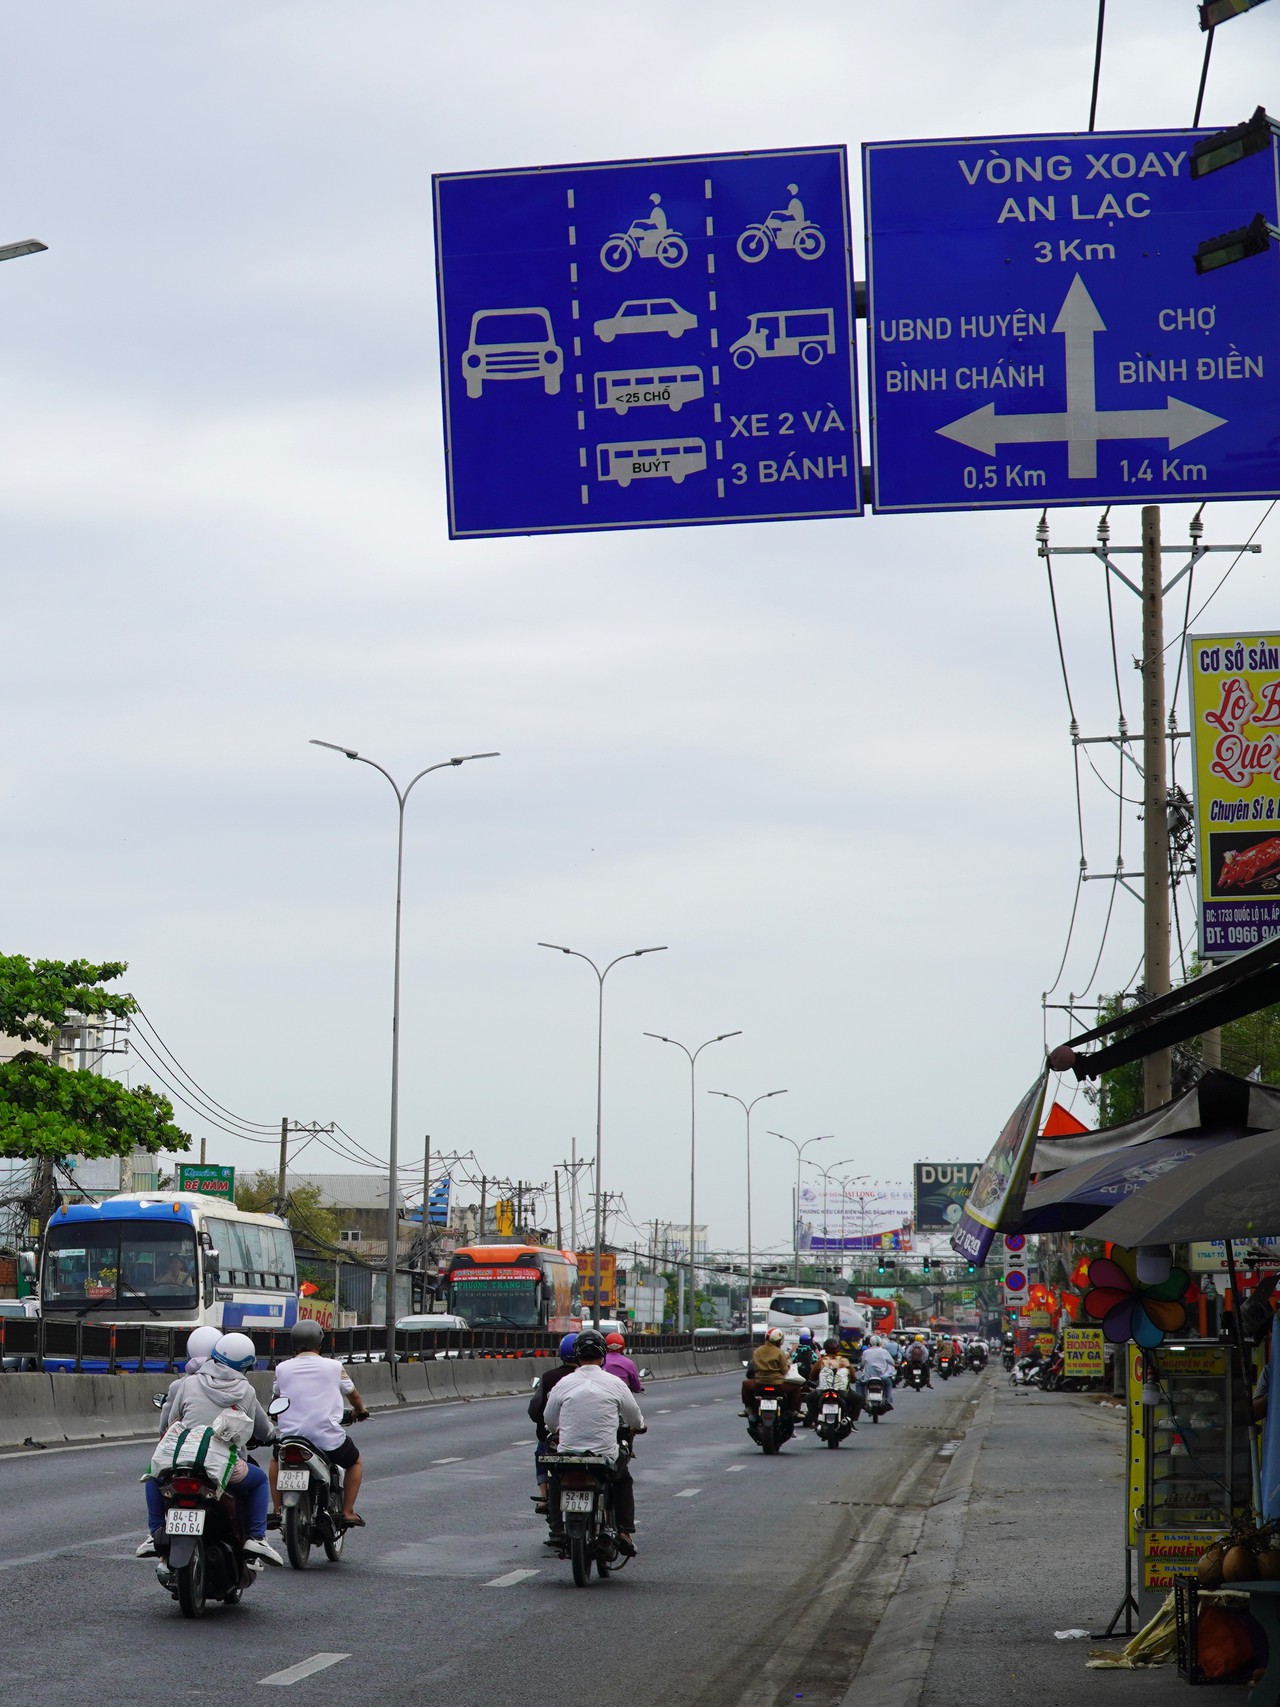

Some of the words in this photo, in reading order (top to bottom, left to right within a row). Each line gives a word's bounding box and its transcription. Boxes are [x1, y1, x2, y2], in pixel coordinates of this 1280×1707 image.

[959, 149, 1073, 185] VÒNG
[1085, 151, 1188, 181] XOAY
[996, 195, 1055, 223] AN
[1072, 192, 1151, 227] LẠC
[880, 317, 952, 342] UBND
[960, 308, 1046, 342] HUYỆN
[1158, 304, 1217, 335] CHỢ
[886, 361, 947, 392] BÌNH
[955, 358, 1045, 390] CHÁNH
[1119, 351, 1188, 384] BÌNH
[1196, 344, 1264, 381] ĐIỀN
[644, 386, 672, 403] CHỖ
[729, 414, 770, 438] XE
[778, 412, 796, 435] 2
[802, 402, 846, 433] VÀ
[631, 455, 671, 474] BUÝT
[731, 462, 749, 485] 3
[758, 451, 848, 484] BÁNH
[963, 465, 998, 490] 0,5
[1006, 464, 1046, 488] Km
[1120, 459, 1154, 484] 1,4
[1162, 458, 1208, 482] Km
[1200, 647, 1221, 672] CƠ
[1224, 641, 1245, 671] SỞ
[1248, 641, 1279, 670] SẢN
[1205, 678, 1250, 732] Lò
[1211, 734, 1273, 783] Quê
[1210, 798, 1250, 824] Chuyên
[1266, 798, 1275, 820] &
[1218, 909, 1233, 922] 1733
[1206, 926, 1225, 945] ĐT:
[1228, 925, 1259, 944] 0966
[492, 1281, 520, 1289] TRANG
[1066, 1341, 1101, 1349] HONDA
[1082, 1331, 1090, 1340] Xe
[1067, 1351, 1084, 1360] TAY
[1087, 1351, 1101, 1360] GA
[172, 1511, 198, 1522] 84-E1
[565, 1501, 589, 1511] 7047
[168, 1522, 201, 1533] 360.64
[1149, 1542, 1205, 1557] NGUYỄN
